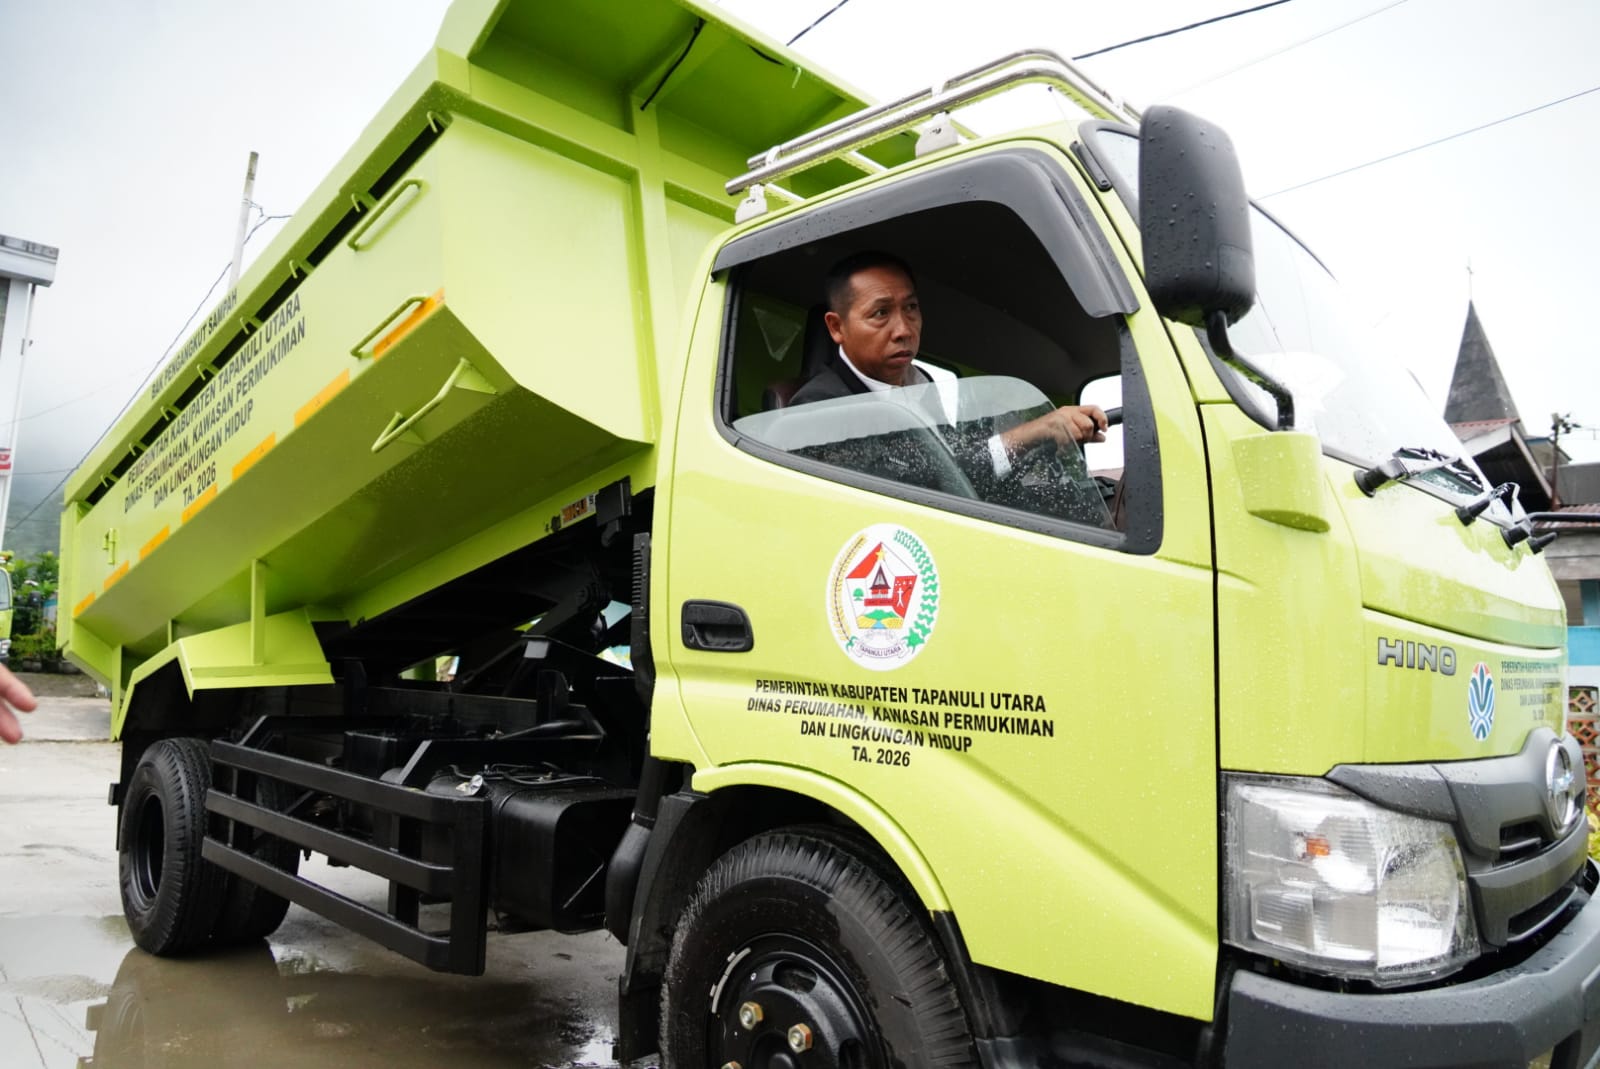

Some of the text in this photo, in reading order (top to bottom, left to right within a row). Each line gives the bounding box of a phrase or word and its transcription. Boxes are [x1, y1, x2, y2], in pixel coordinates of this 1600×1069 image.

[170, 380, 216, 444] KABUPATEN
[218, 331, 262, 392] TAPANULI
[265, 292, 301, 344] UTARA
[192, 387, 234, 447] KAWASAN
[236, 316, 305, 402] PERMUKIMAN
[154, 398, 254, 509] DAN LINGKUNGAN HIDUP
[197, 461, 216, 495] 2026
[1377, 636, 1457, 676] HINO
[755, 679, 1046, 713] PEMERINTAH KABUPATEN TAPANULI UTARA
[747, 696, 1055, 738] DINAS PERUMAHAN, KAWASAN PERMUKIMAN
[800, 720, 973, 753] DAN LINGKUNGAN HIDUP
[851, 745, 911, 767] TA. 2026
